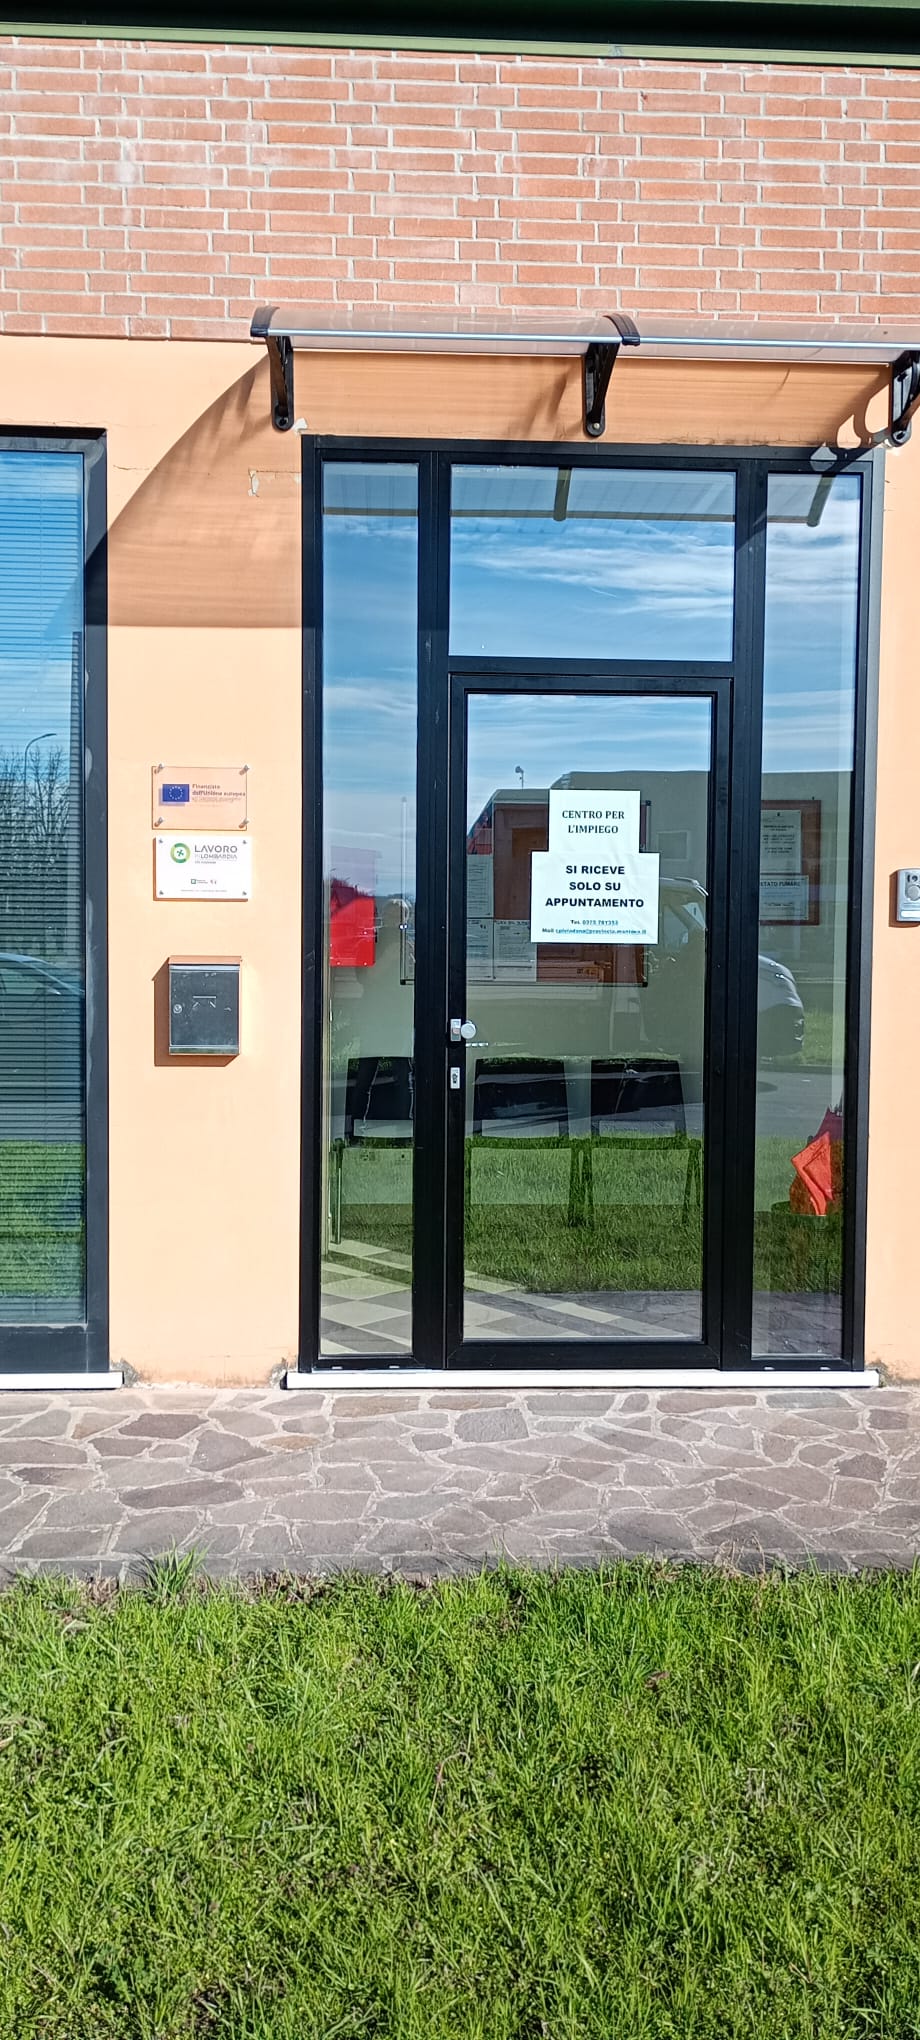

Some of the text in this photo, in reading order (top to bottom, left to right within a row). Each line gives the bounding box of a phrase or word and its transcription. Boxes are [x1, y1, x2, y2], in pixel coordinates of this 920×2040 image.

[562, 810, 625, 820] CENTRO PER
[568, 825, 619, 834] L'IMPIEGO
[194, 844, 238, 853] LAVORO
[565, 865, 625, 875] SI RICEVE
[569, 881, 621, 891] SOLO SU
[545, 897, 644, 908] APPUNTAMENTO
